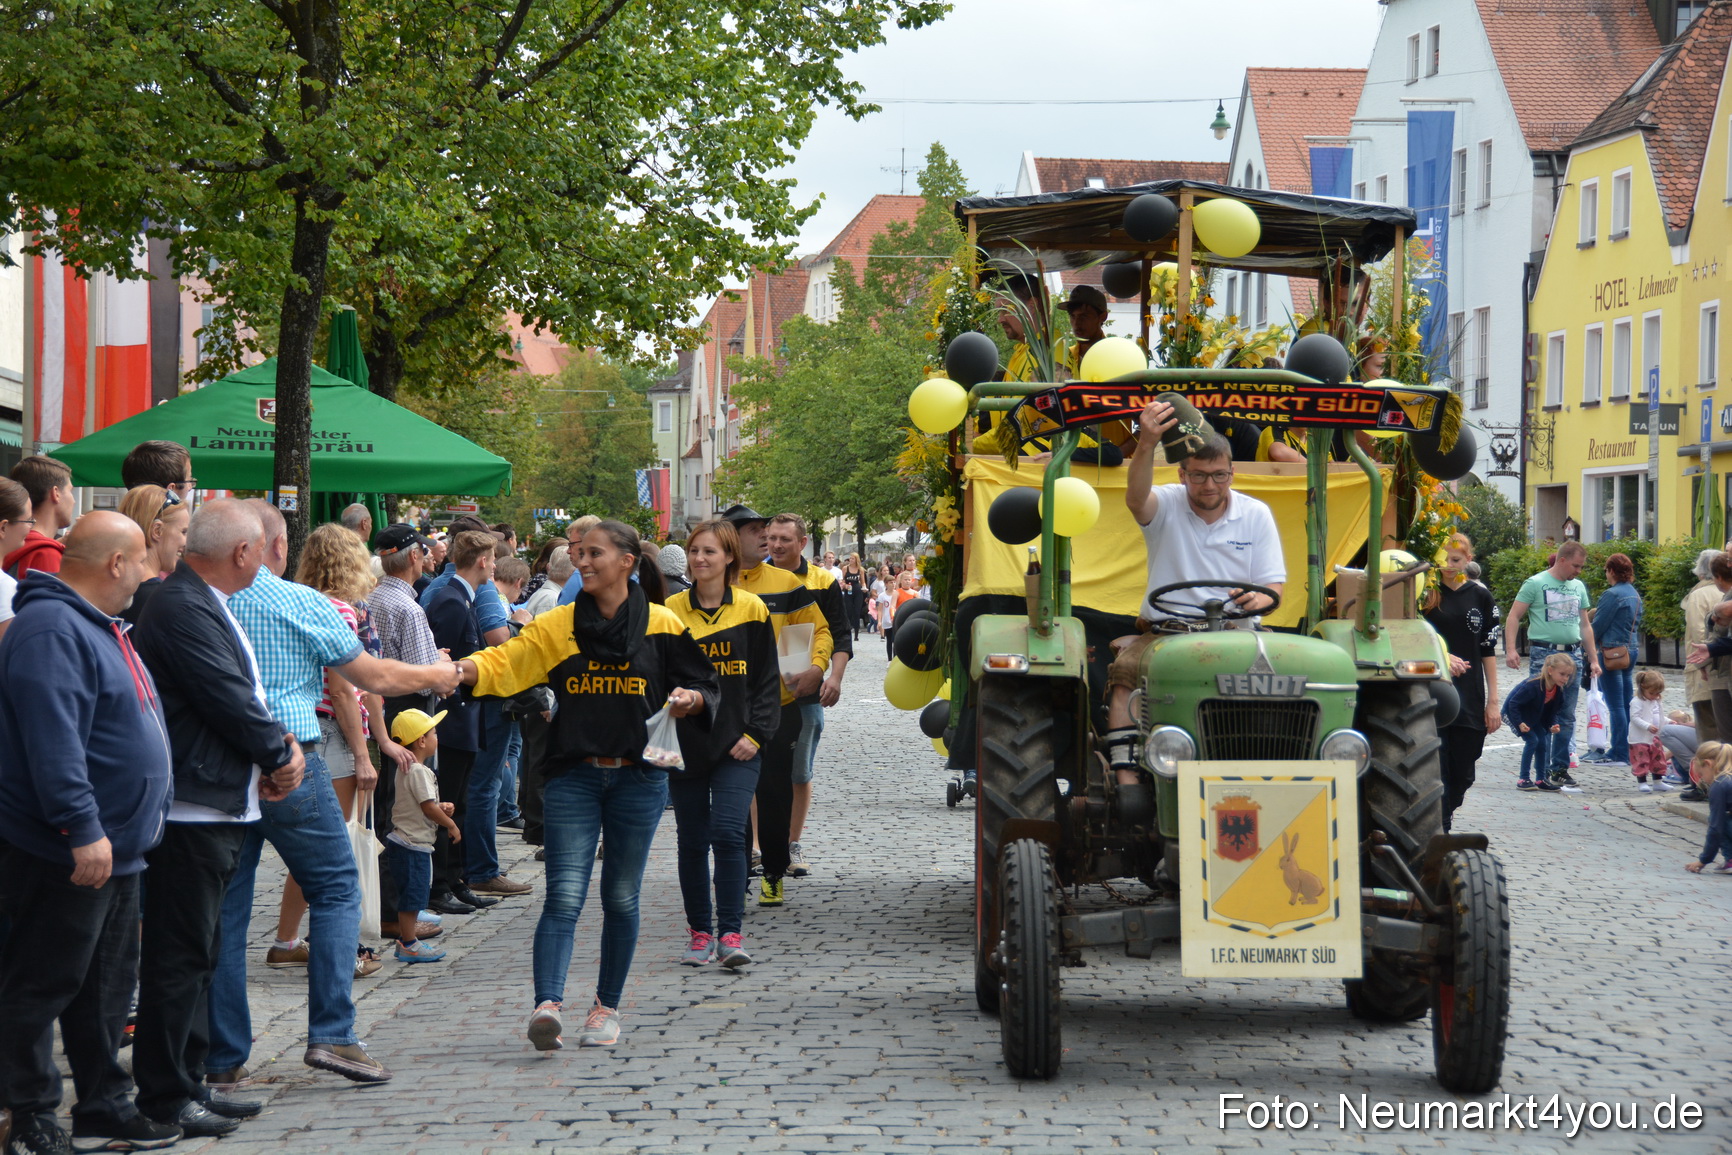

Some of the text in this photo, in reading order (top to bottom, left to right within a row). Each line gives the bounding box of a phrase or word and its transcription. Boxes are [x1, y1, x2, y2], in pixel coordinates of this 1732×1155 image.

[1434, 217, 1443, 278] RUPPERT
[1595, 270, 1679, 312] HOTEL Lehmeier
[1143, 381, 1296, 393] YOU'LL NEVER
[1082, 394, 1123, 408] FC
[1129, 393, 1311, 411] NMARKT
[1317, 393, 1382, 414] SÜD
[1219, 411, 1291, 422] ALONE
[1633, 422, 1677, 431] TAUN
[1702, 404, 1710, 438] P
[217, 427, 351, 439] Neumkter
[190, 436, 374, 453] Lammräu
[1587, 437, 1637, 460] Restaurant
[712, 660, 748, 676] TNER
[565, 673, 648, 696] GÄRTNER
[1217, 674, 1307, 696] FENDT
[1240, 948, 1307, 963] NEUMARKT
[1312, 945, 1336, 964] SÜD
